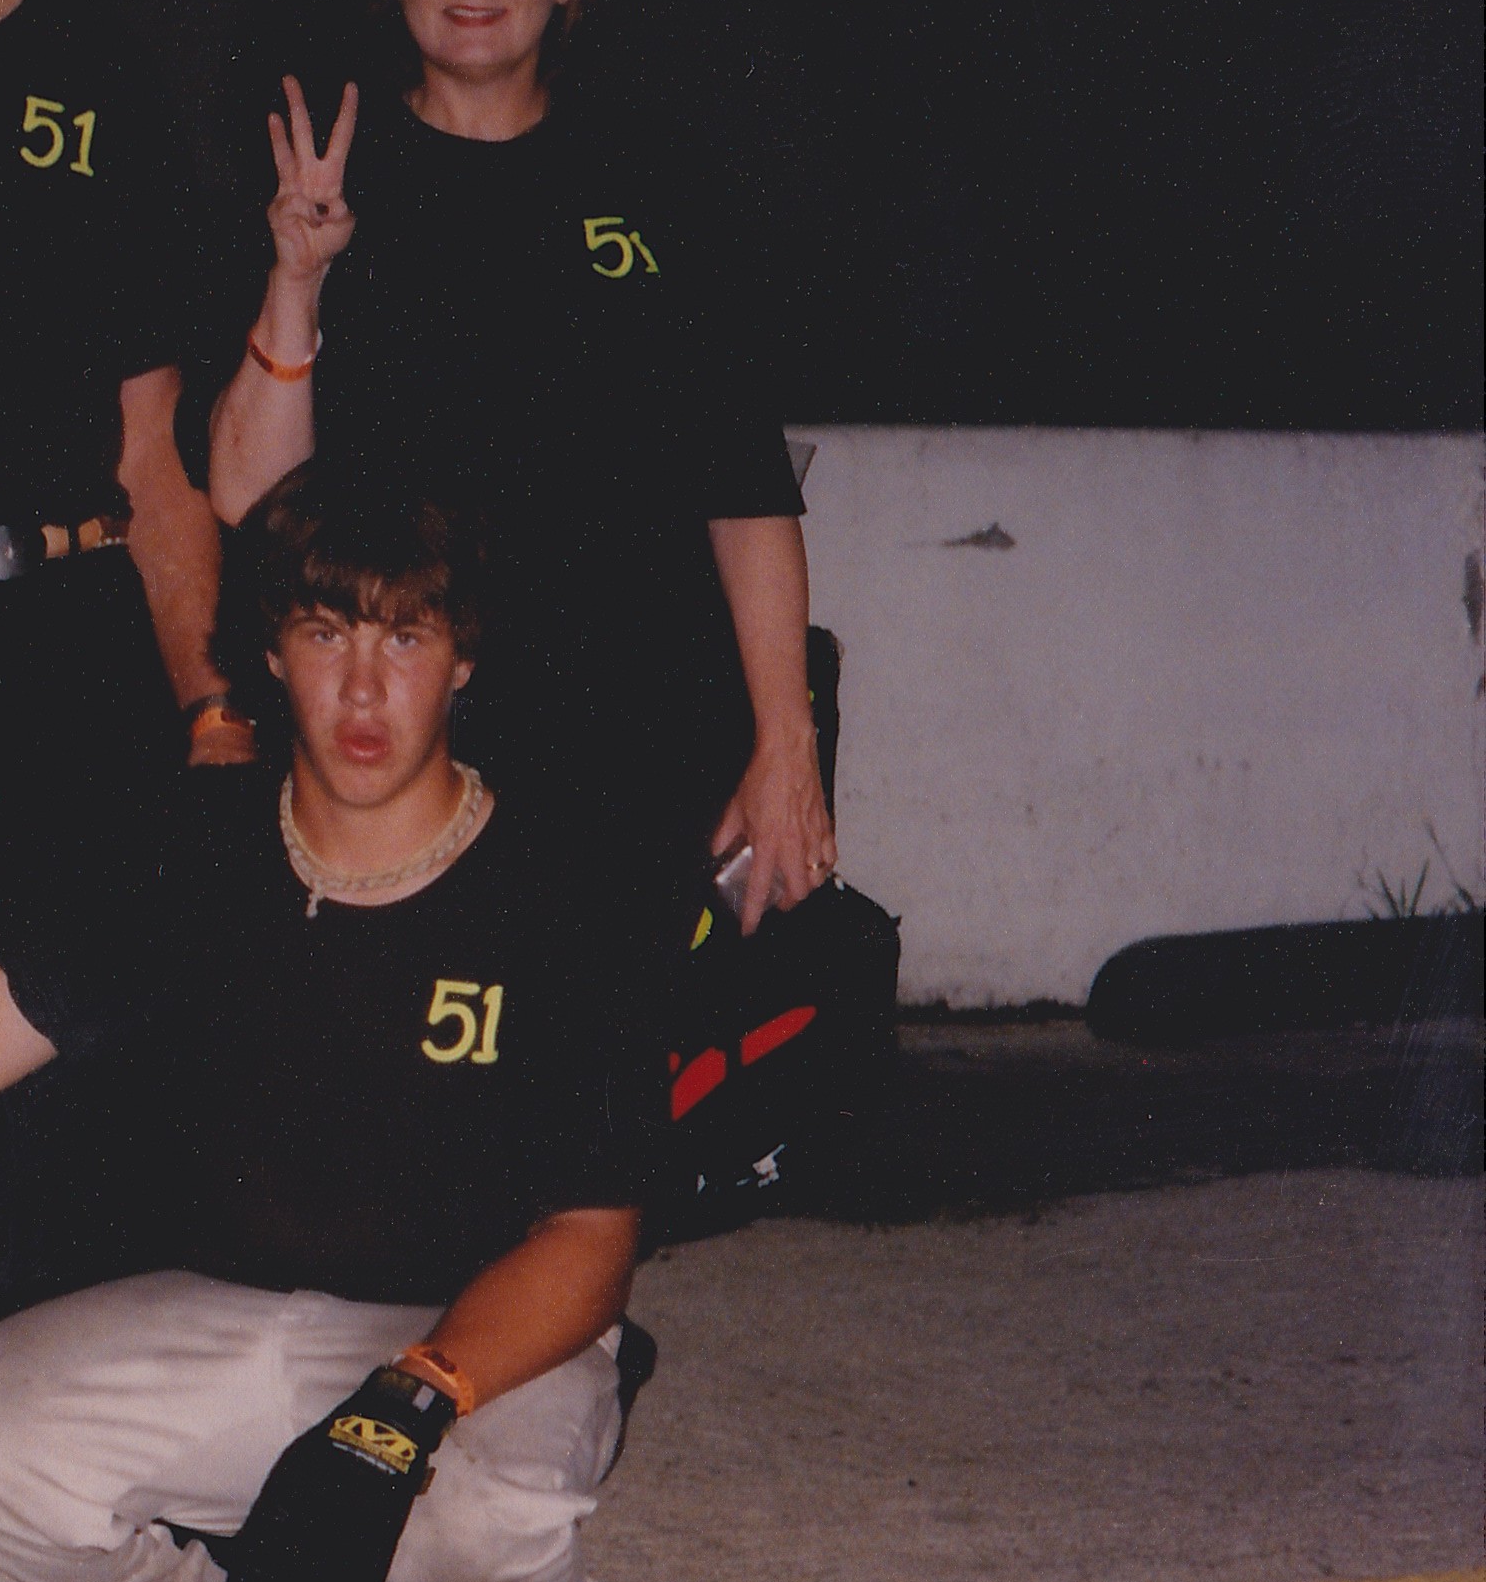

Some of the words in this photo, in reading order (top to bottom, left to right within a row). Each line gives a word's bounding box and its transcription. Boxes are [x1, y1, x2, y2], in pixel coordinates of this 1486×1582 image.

[20, 96, 96, 176] 51
[583, 216, 660, 279] 51
[421, 978, 504, 1065] 51
